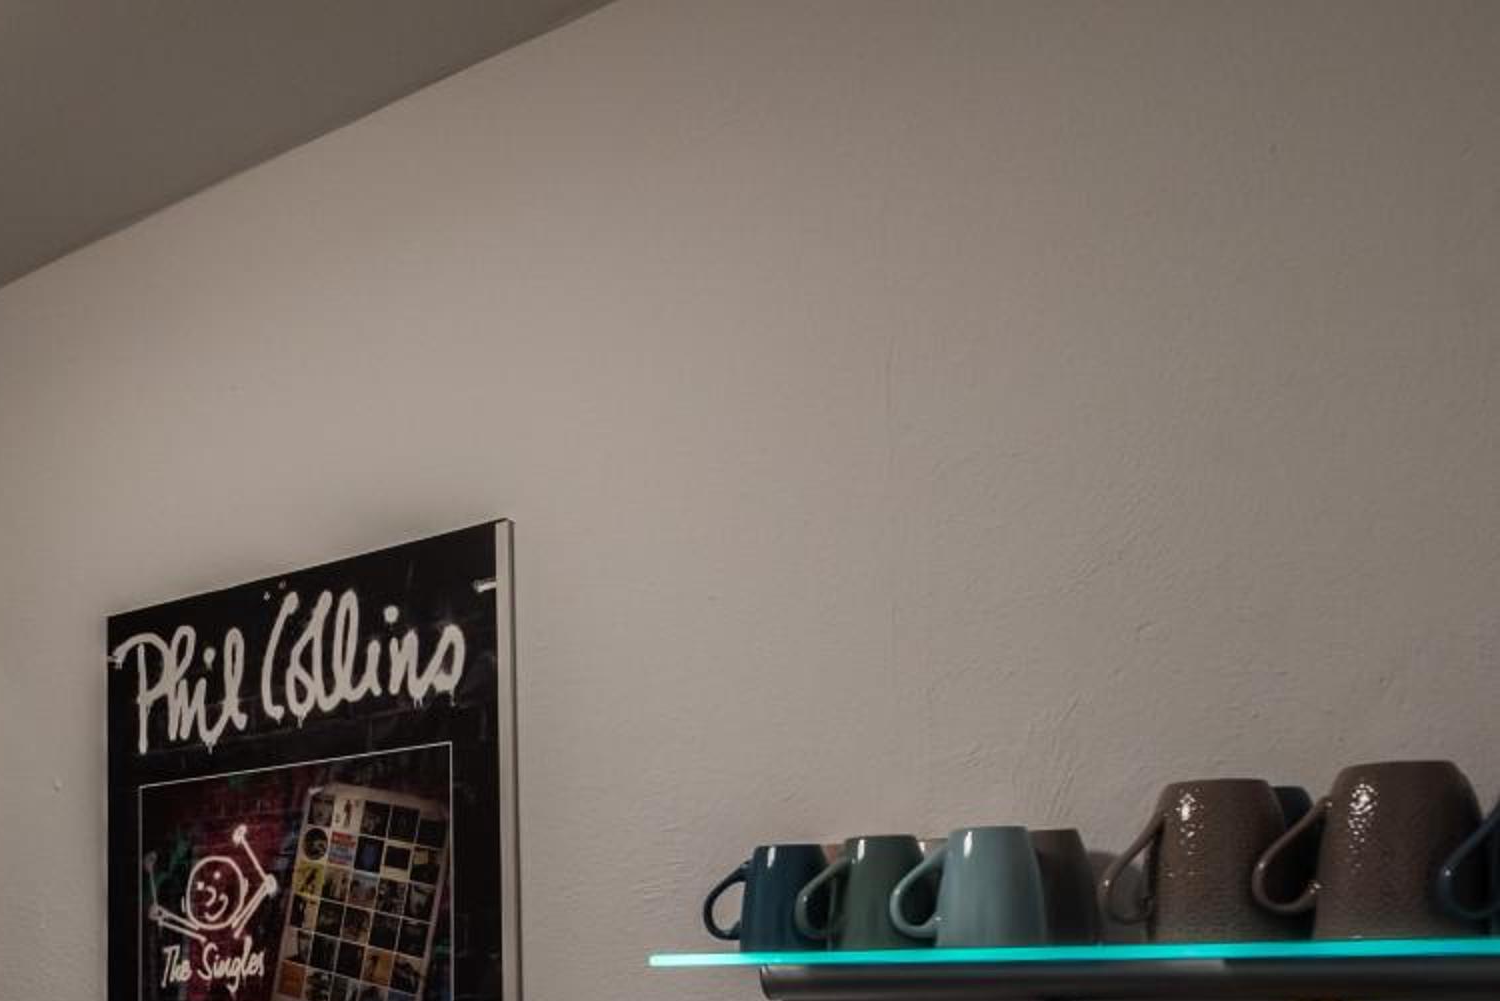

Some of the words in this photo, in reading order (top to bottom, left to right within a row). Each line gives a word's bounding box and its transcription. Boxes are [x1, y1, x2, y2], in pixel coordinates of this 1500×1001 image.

[113, 625, 248, 754] Phil
[261, 589, 467, 726] Collins
[161, 944, 192, 988] The
[196, 934, 265, 992] Singles
